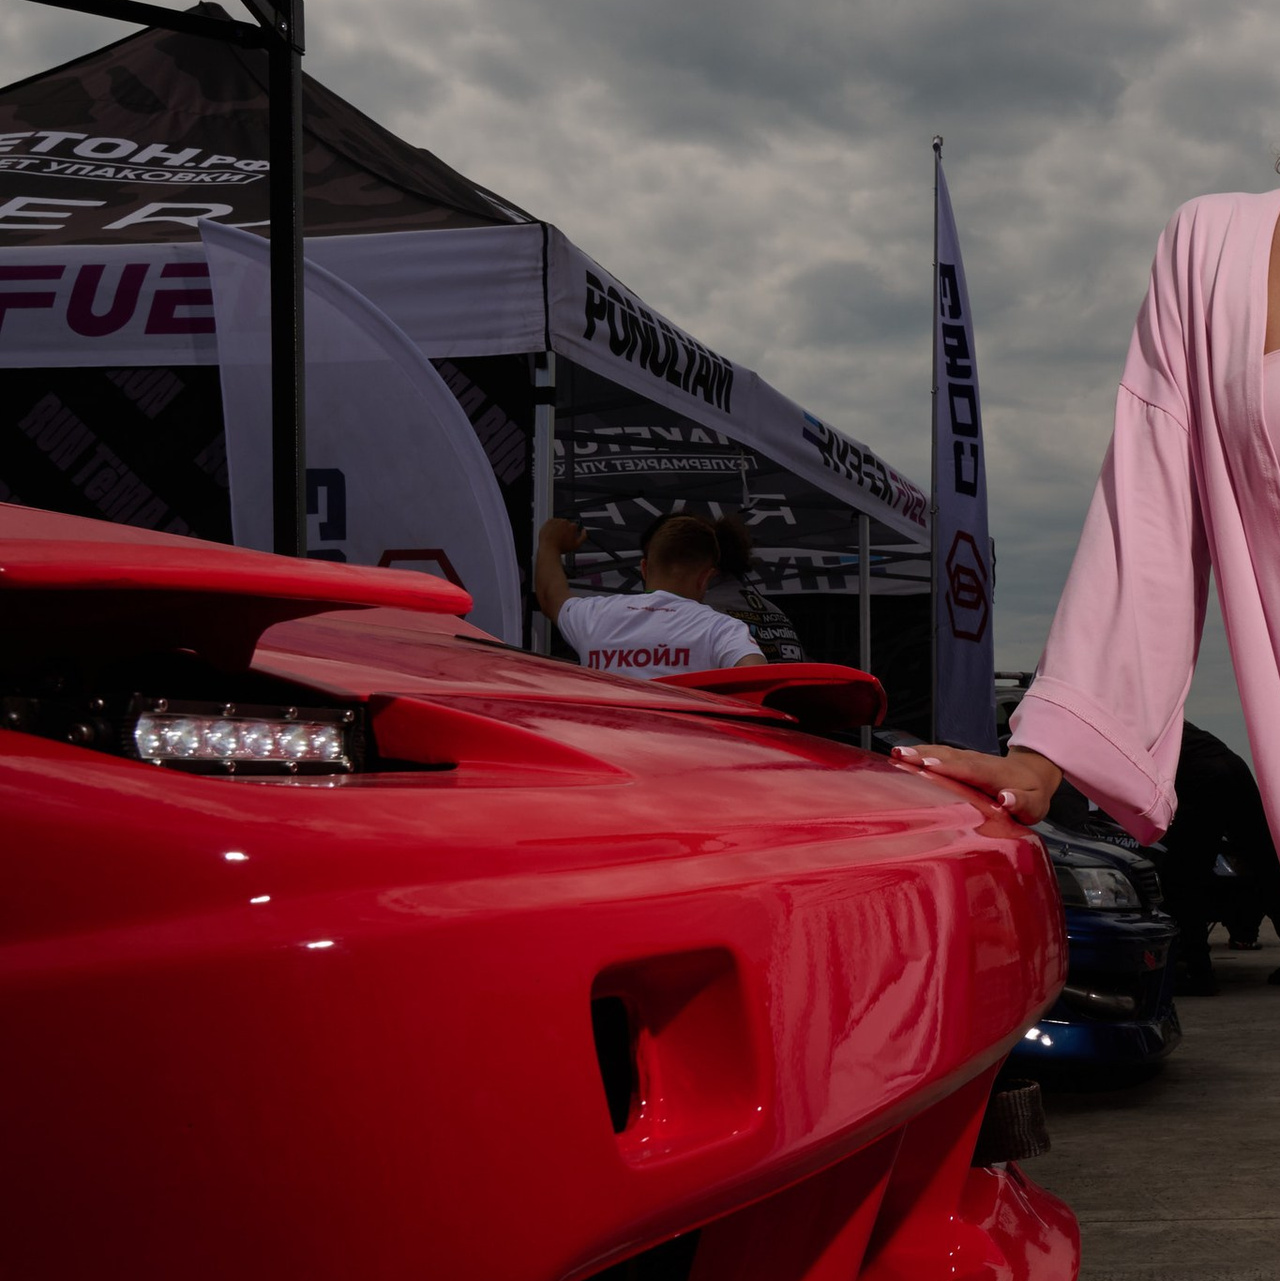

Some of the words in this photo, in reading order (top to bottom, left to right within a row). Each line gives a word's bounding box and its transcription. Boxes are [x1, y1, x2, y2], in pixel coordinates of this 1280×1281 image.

[42, 161, 248, 183] УПАКОВКИ
[583, 270, 734, 414] PONULYAM
[17, 389, 98, 472] RUN
[588, 644, 690, 670] ЛУКОЙЛ
